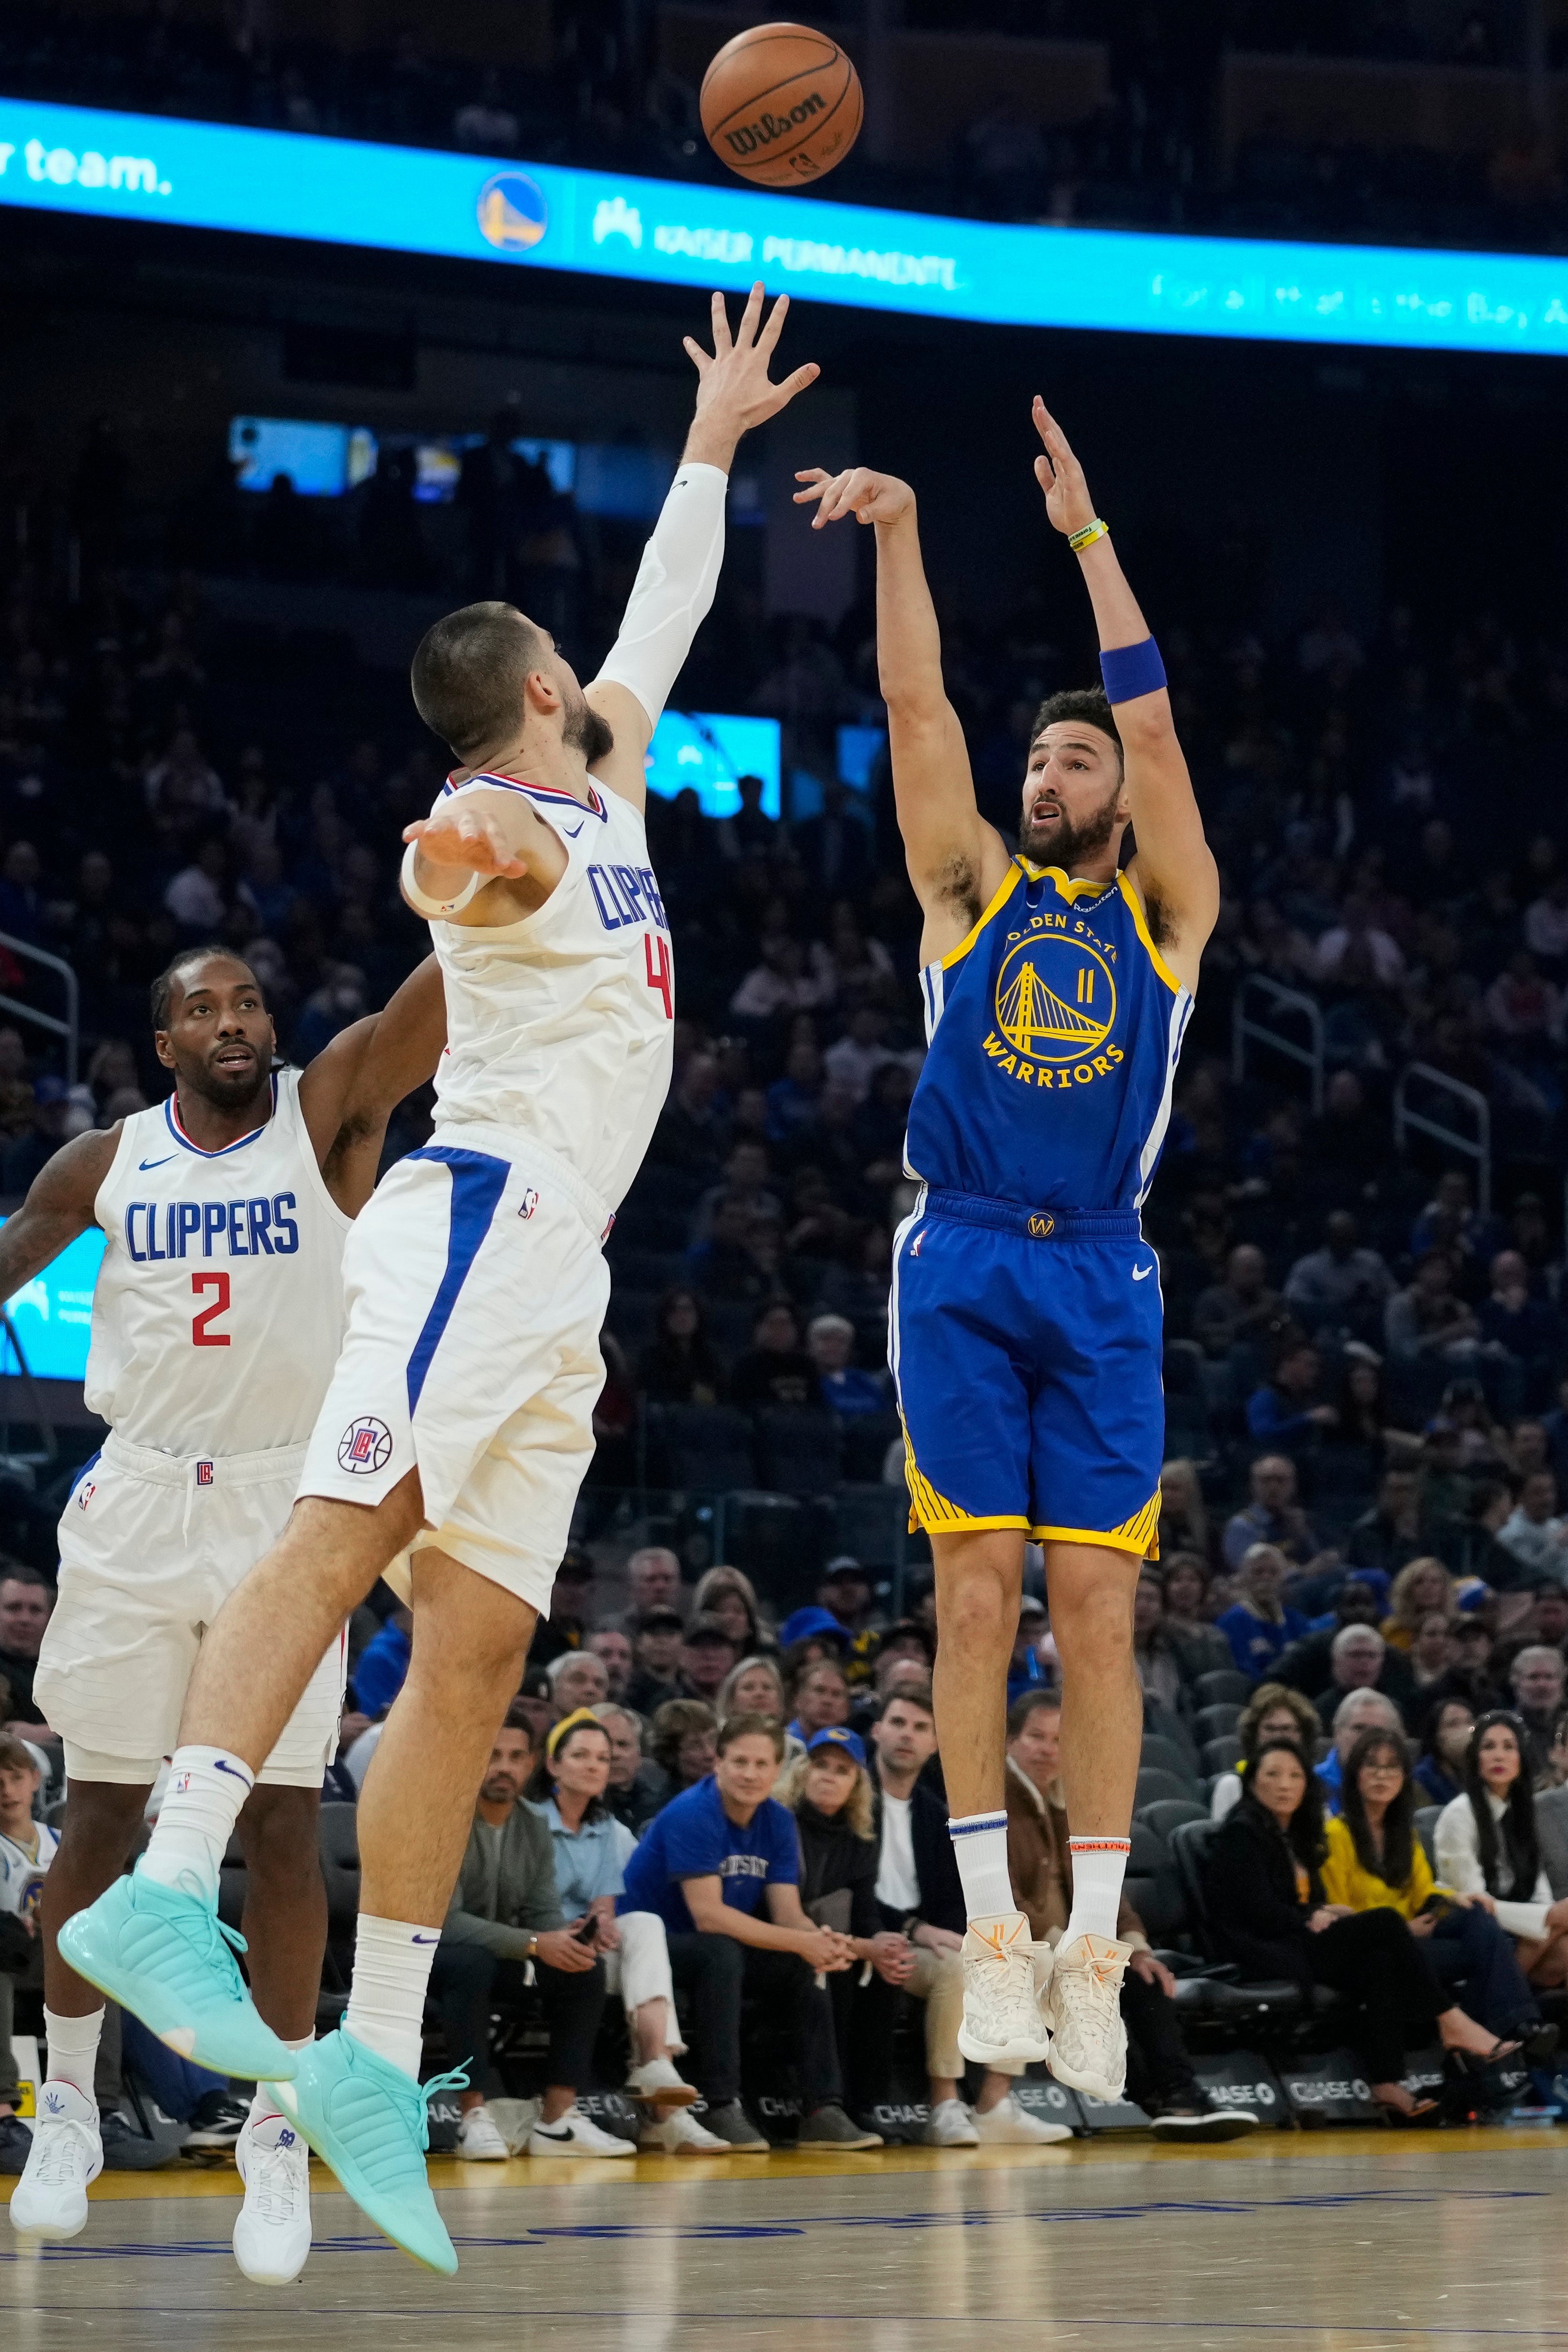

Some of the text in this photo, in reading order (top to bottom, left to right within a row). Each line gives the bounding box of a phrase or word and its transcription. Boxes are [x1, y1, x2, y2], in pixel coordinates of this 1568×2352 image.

[724, 92, 827, 156] Wilson
[25, 138, 172, 196] team.
[654, 224, 754, 263] KAISER
[1073, 886, 1118, 913] Rakuten
[1005, 914, 1117, 964] OLDEN STATE
[645, 933, 673, 1019] 4
[1077, 968, 1094, 1004] 11
[982, 1030, 1124, 1089] WARRIORS
[126, 1191, 300, 1262] CLIPPERS
[192, 1272, 231, 1346] 2
[428, 2103, 463, 2123] HAS
[874, 2104, 928, 2123] CHAS
